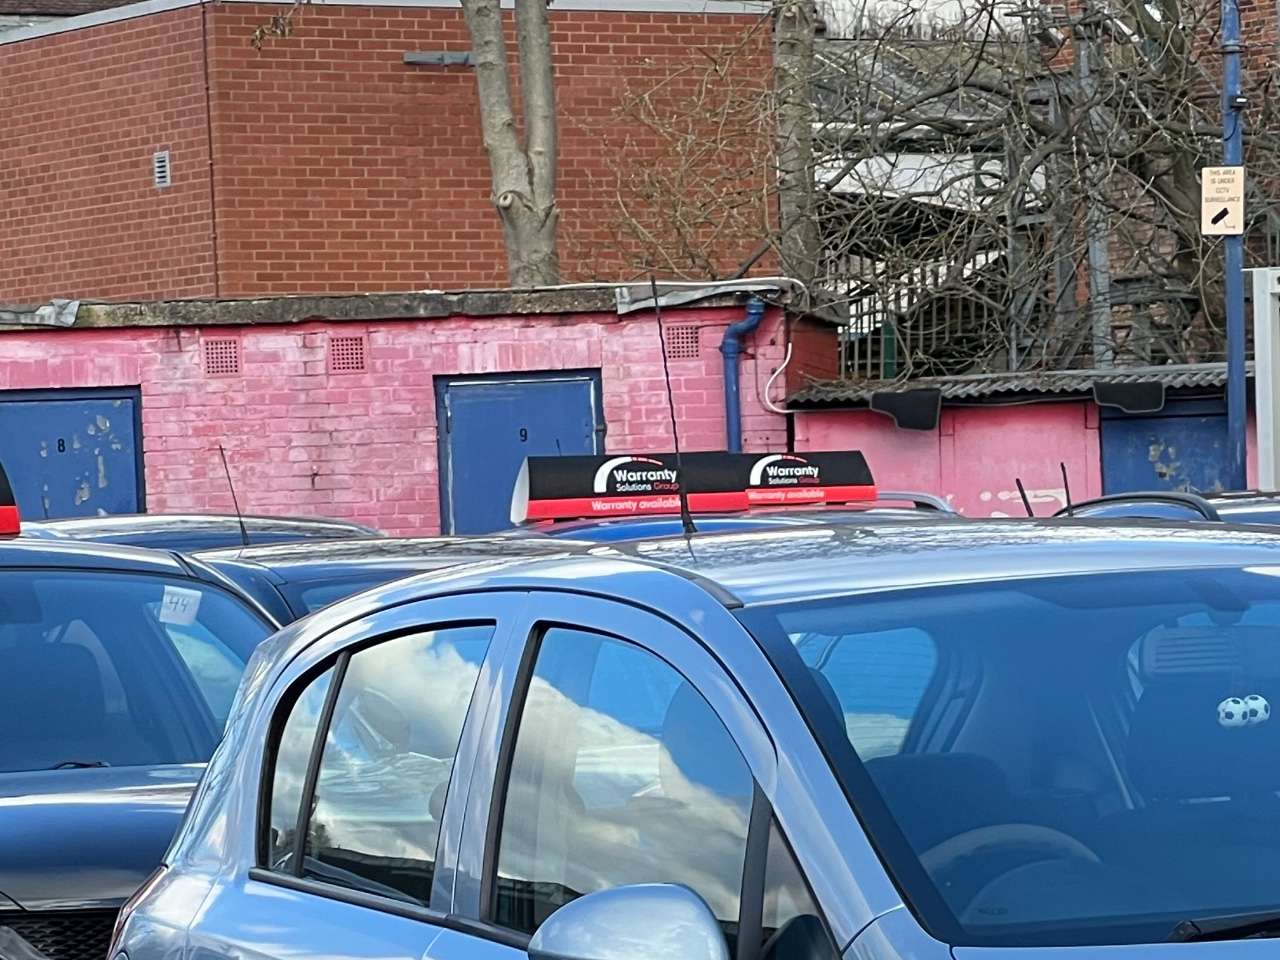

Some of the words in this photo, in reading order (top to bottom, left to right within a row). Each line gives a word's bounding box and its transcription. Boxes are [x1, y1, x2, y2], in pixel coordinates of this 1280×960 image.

[519, 428, 528, 442] 9
[57, 438, 66, 453] 8
[613, 468, 677, 483] Warranty
[766, 465, 819, 478] Warranty
[616, 482, 652, 492] Solutions
[653, 481, 680, 492] Group
[591, 500, 638, 512] Warranty
[638, 497, 681, 509] availabl
